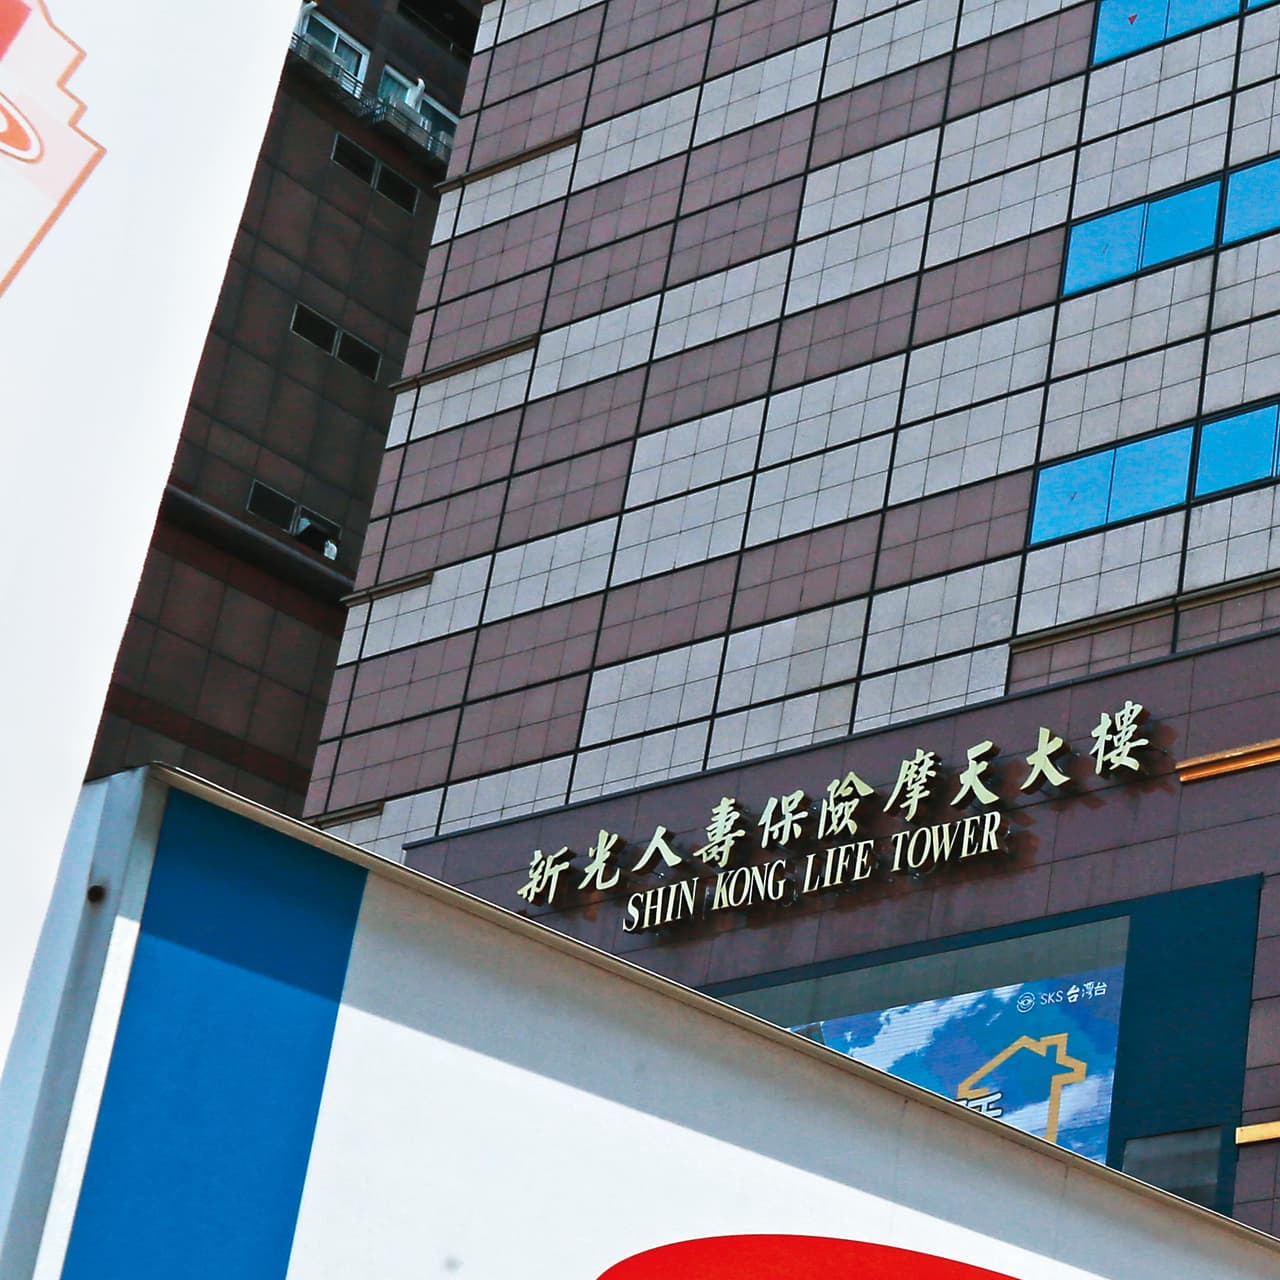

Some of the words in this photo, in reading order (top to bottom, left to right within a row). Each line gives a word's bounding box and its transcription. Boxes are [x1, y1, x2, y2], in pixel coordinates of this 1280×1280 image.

[516, 699, 1151, 906] 新光人壽保險摩天大樓
[622, 876, 698, 933] SHIN
[711, 860, 788, 912] KONG
[801, 838, 874, 894] LIFE
[888, 811, 1002, 873] TOWER
[1040, 990, 1064, 1006] SKS
